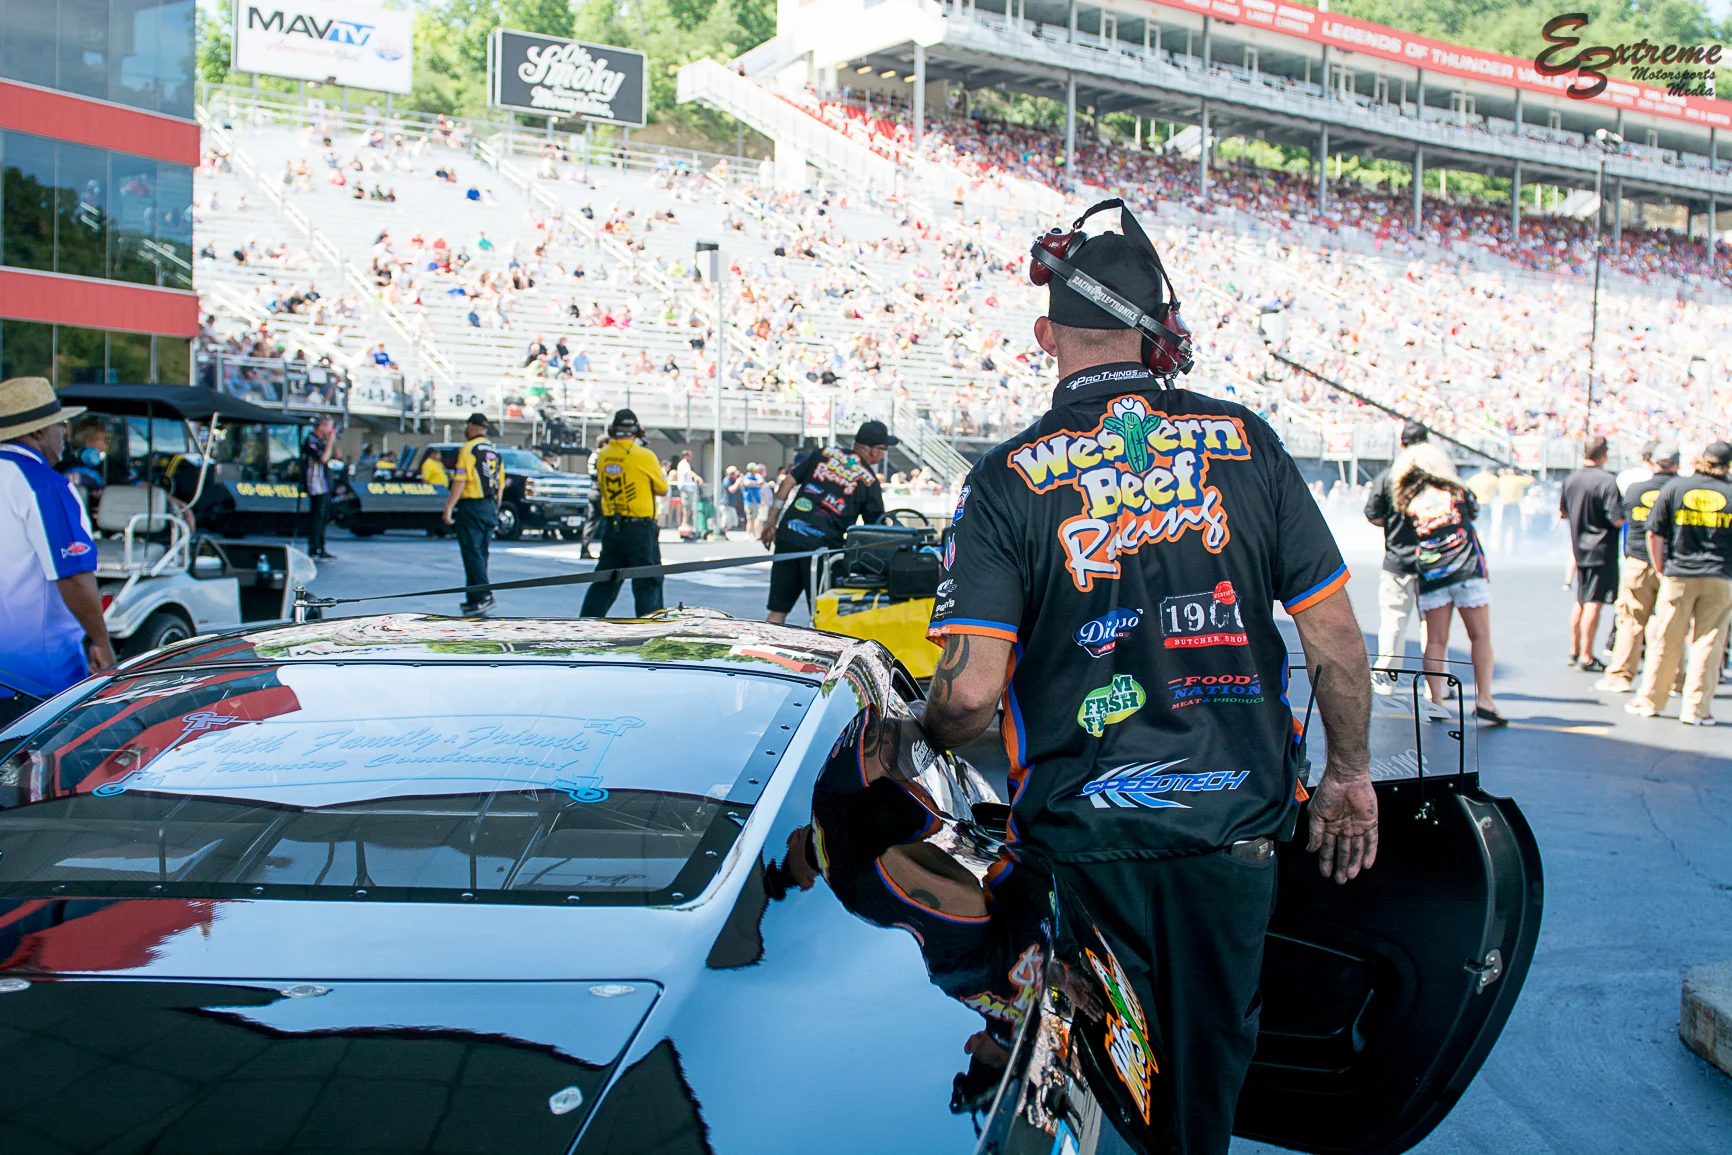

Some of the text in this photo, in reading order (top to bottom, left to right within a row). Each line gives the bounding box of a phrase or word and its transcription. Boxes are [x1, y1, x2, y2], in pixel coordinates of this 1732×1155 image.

[248, 6, 375, 46] MAVTV
[1321, 20, 1401, 53] LEGENDS
[1404, 42, 1429, 59] OF
[1430, 48, 1514, 79] THUNDER
[517, 44, 626, 102] Smoky
[1080, 450, 1197, 519] Beef
[1175, 636, 1220, 645] BUTCHER
[1173, 684, 1261, 699] NATION
[1184, 674, 1251, 686] FOOD
[1171, 698, 1202, 709] MEAT
[180, 730, 298, 757] Faith
[302, 726, 442, 757] Family
[458, 722, 591, 752] Friends
[1076, 771, 1251, 797] SPEEDTECH
